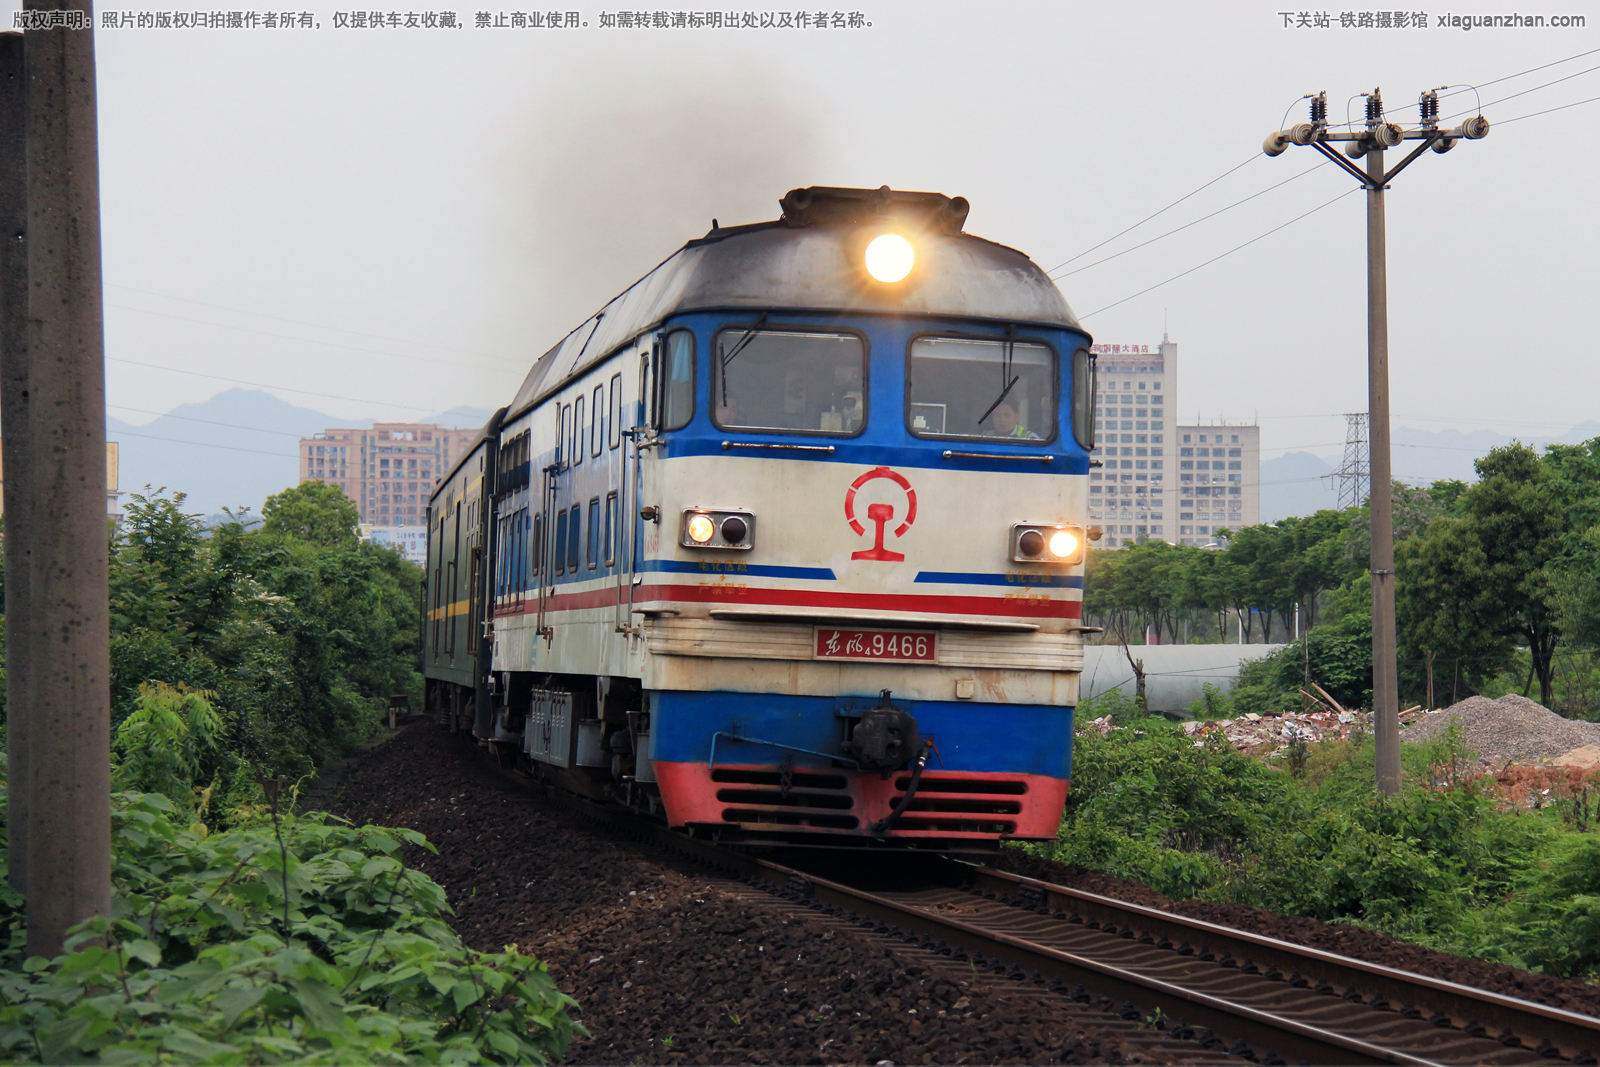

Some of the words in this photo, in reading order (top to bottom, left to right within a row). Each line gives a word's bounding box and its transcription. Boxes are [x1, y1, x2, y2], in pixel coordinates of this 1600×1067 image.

[698, 559, 748, 572] 电化区段
[698, 582, 748, 595] 严禁攀登
